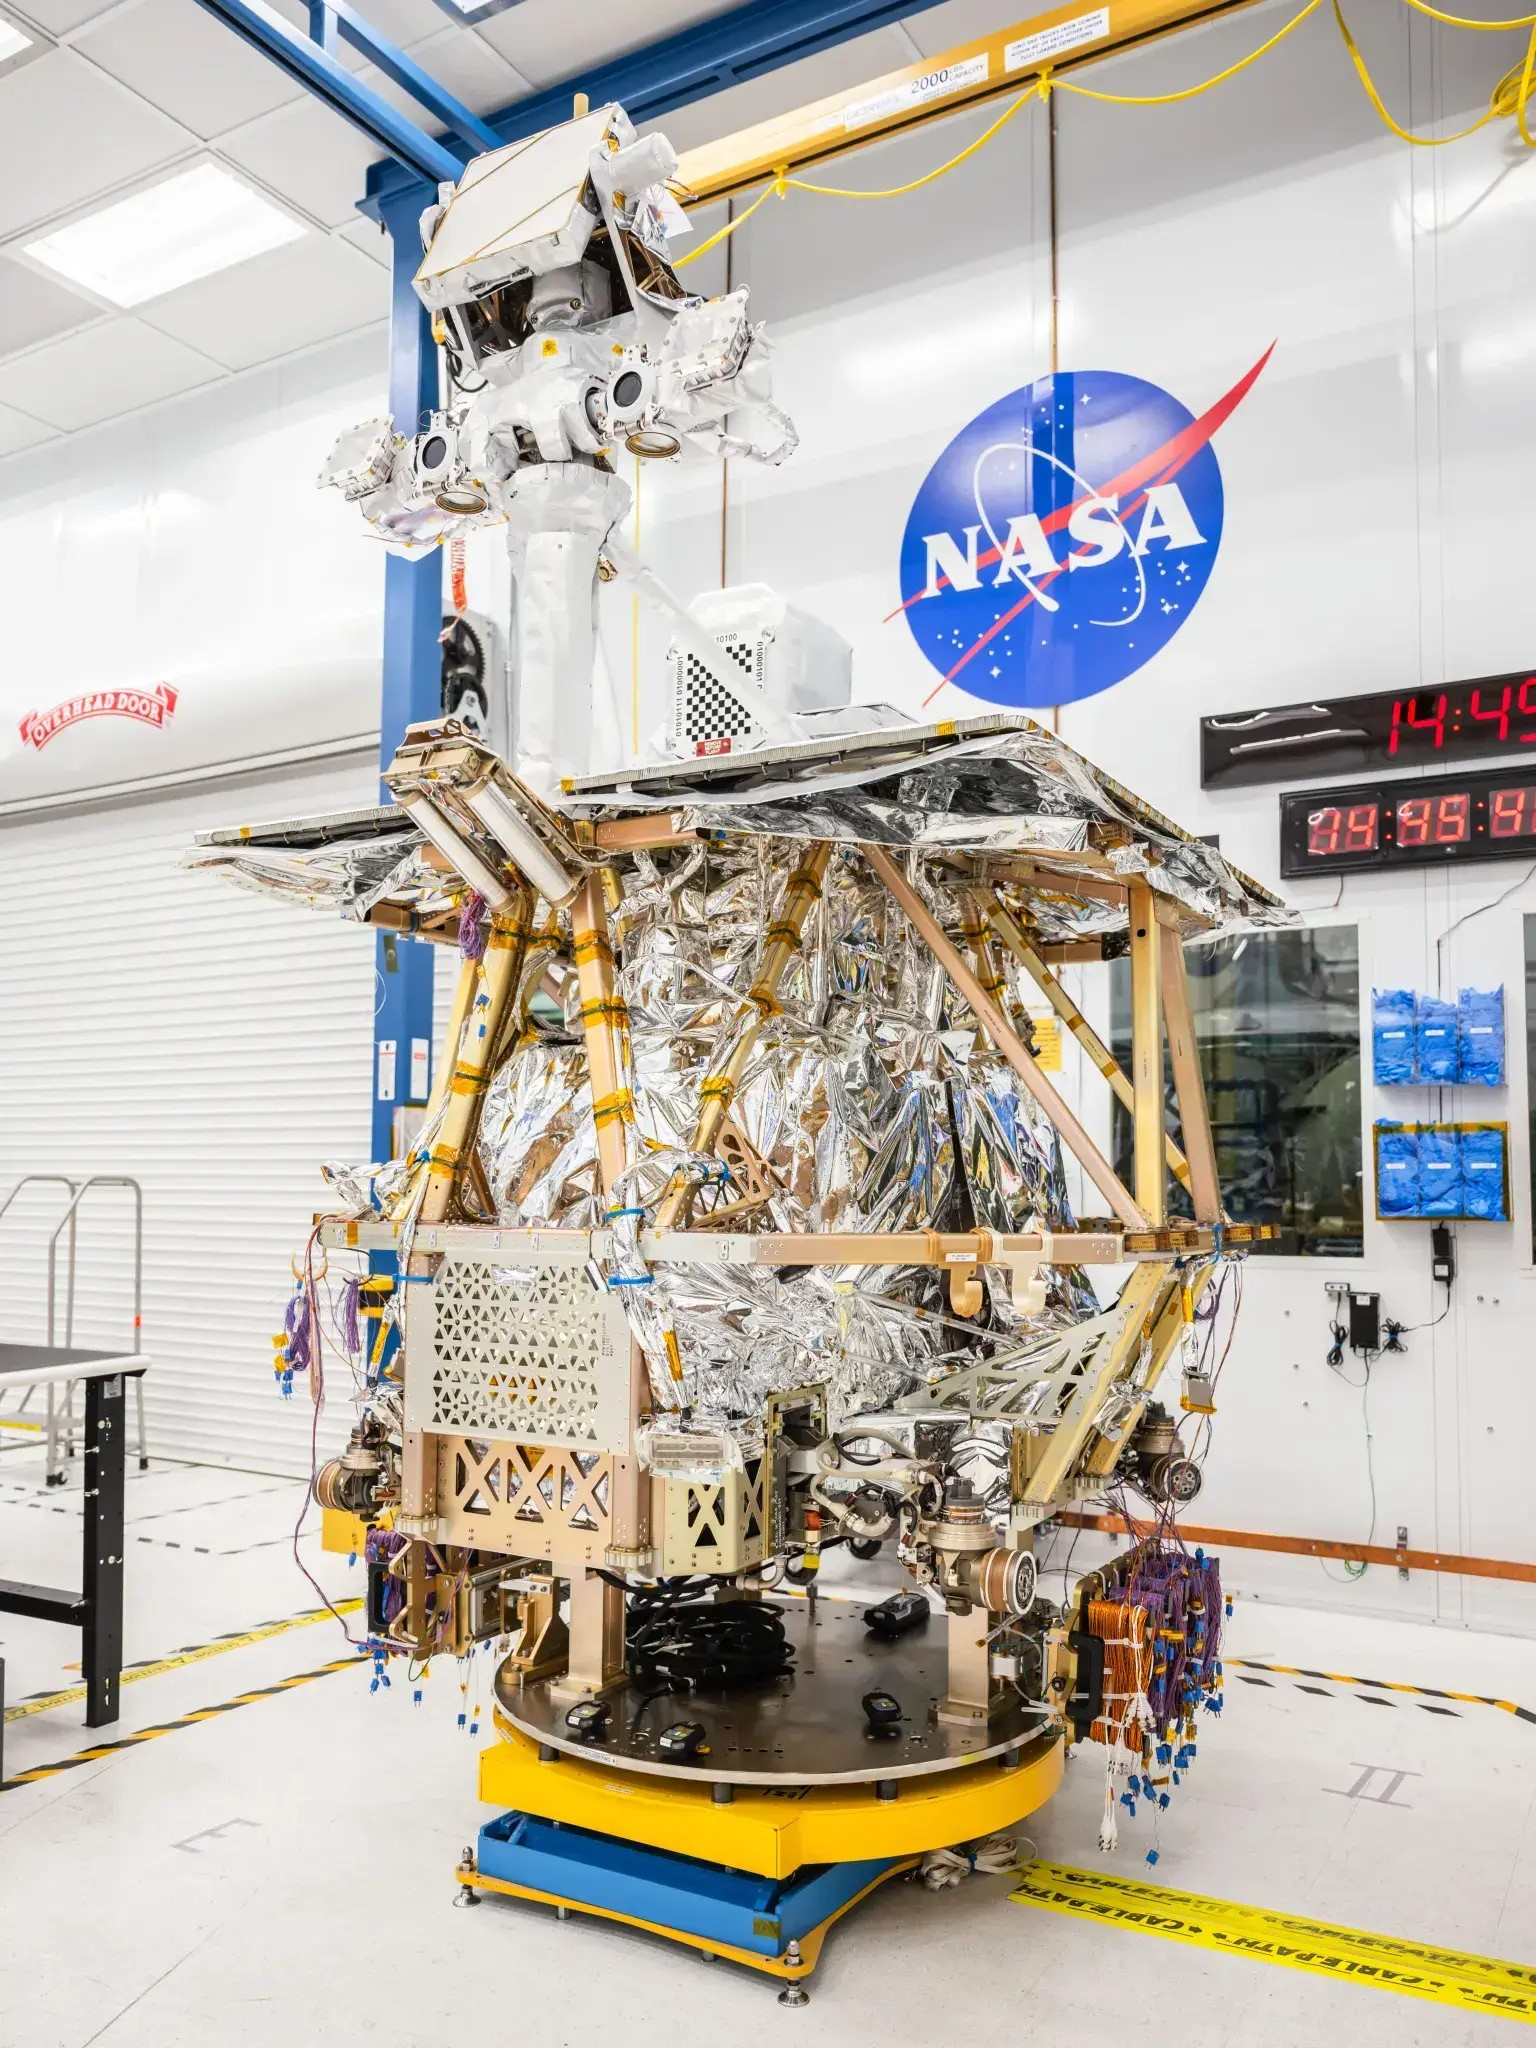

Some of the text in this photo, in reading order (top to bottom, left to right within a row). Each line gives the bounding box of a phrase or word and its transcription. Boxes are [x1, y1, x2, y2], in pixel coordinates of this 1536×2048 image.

[911, 69, 949, 94] 2000
[949, 64, 985, 81] CAPACITY
[921, 482, 1207, 598] NASA
[33, 692, 161, 742] OVERHEAD DOOR
